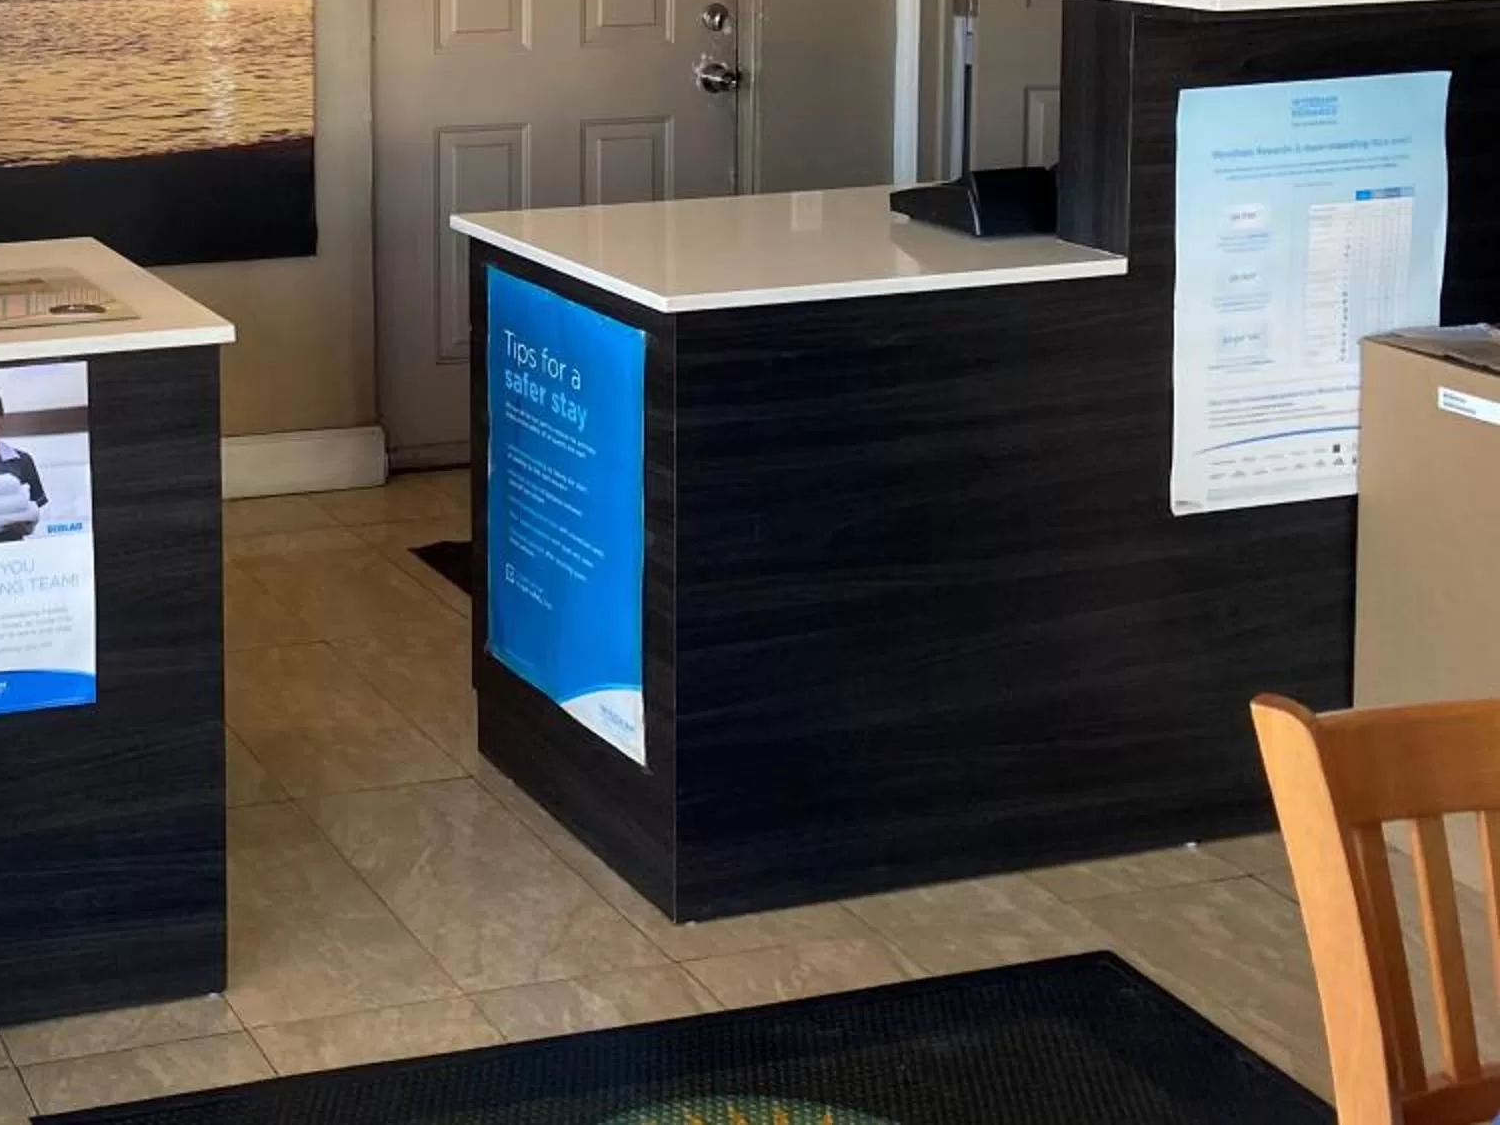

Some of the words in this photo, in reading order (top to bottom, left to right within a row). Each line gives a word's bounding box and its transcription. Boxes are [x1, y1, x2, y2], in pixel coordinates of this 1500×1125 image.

[503, 329, 537, 368] Tips
[542, 347, 567, 381] for
[571, 369, 582, 390] a
[504, 367, 546, 405] safer
[551, 388, 588, 432] stay
[0, 559, 35, 577] YOU
[29, 574, 80, 593] TEAM!
